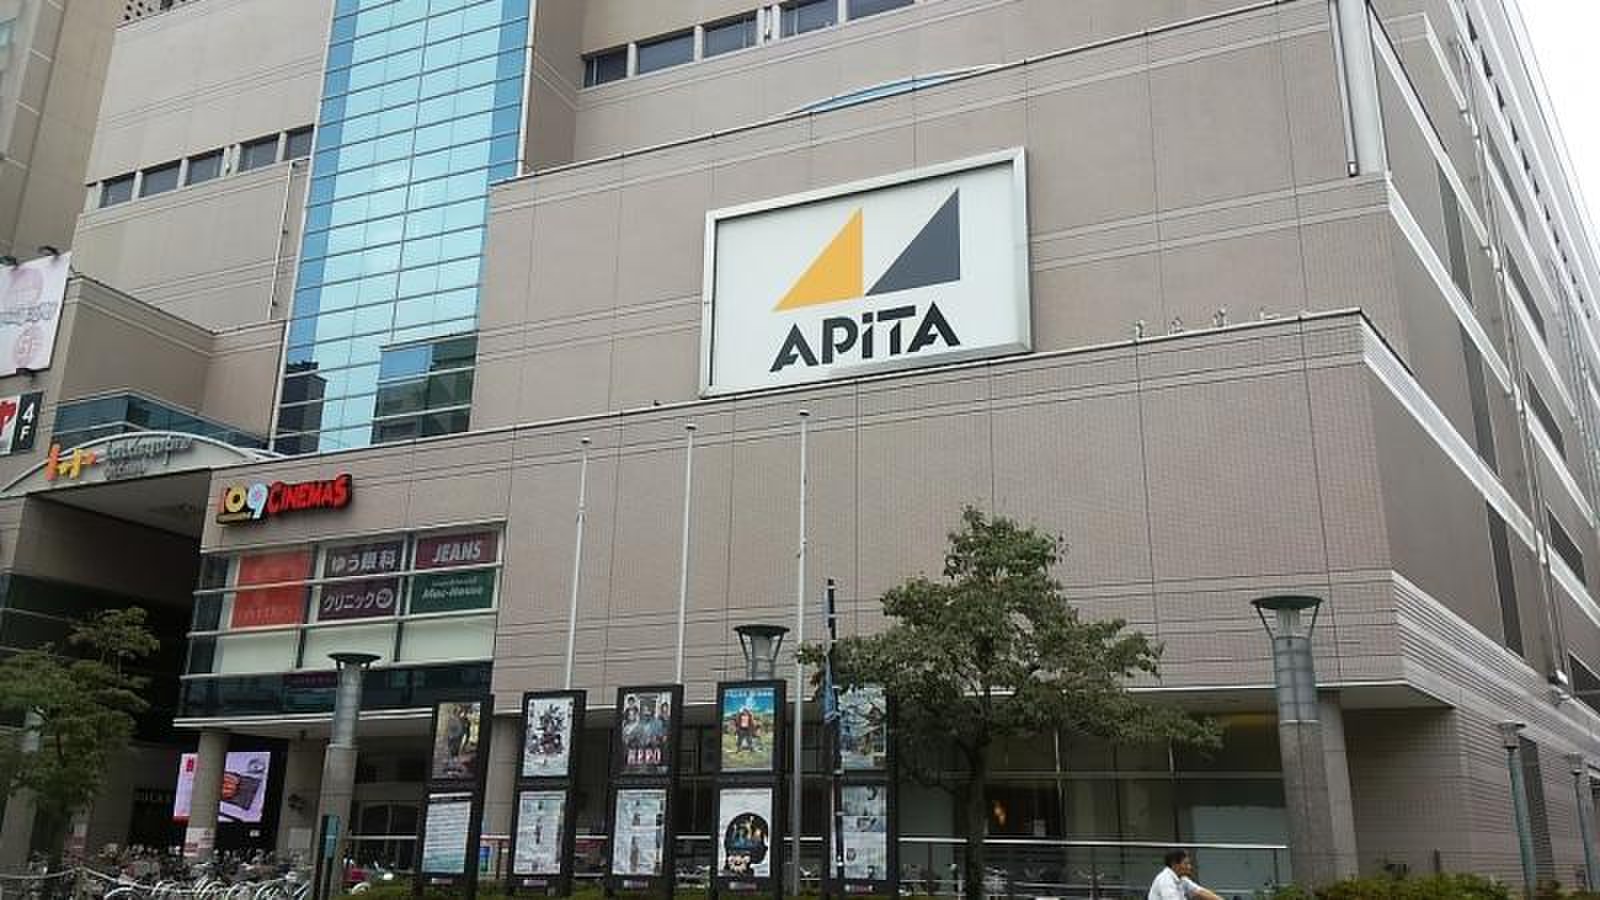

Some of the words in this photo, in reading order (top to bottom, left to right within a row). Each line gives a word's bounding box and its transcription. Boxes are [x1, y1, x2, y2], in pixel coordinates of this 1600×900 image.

[267, 474, 351, 515] CINEMAS
[331, 549, 396, 572] ゆう眼科
[433, 539, 481, 562] JEANS
[323, 592, 375, 612] クリニック
